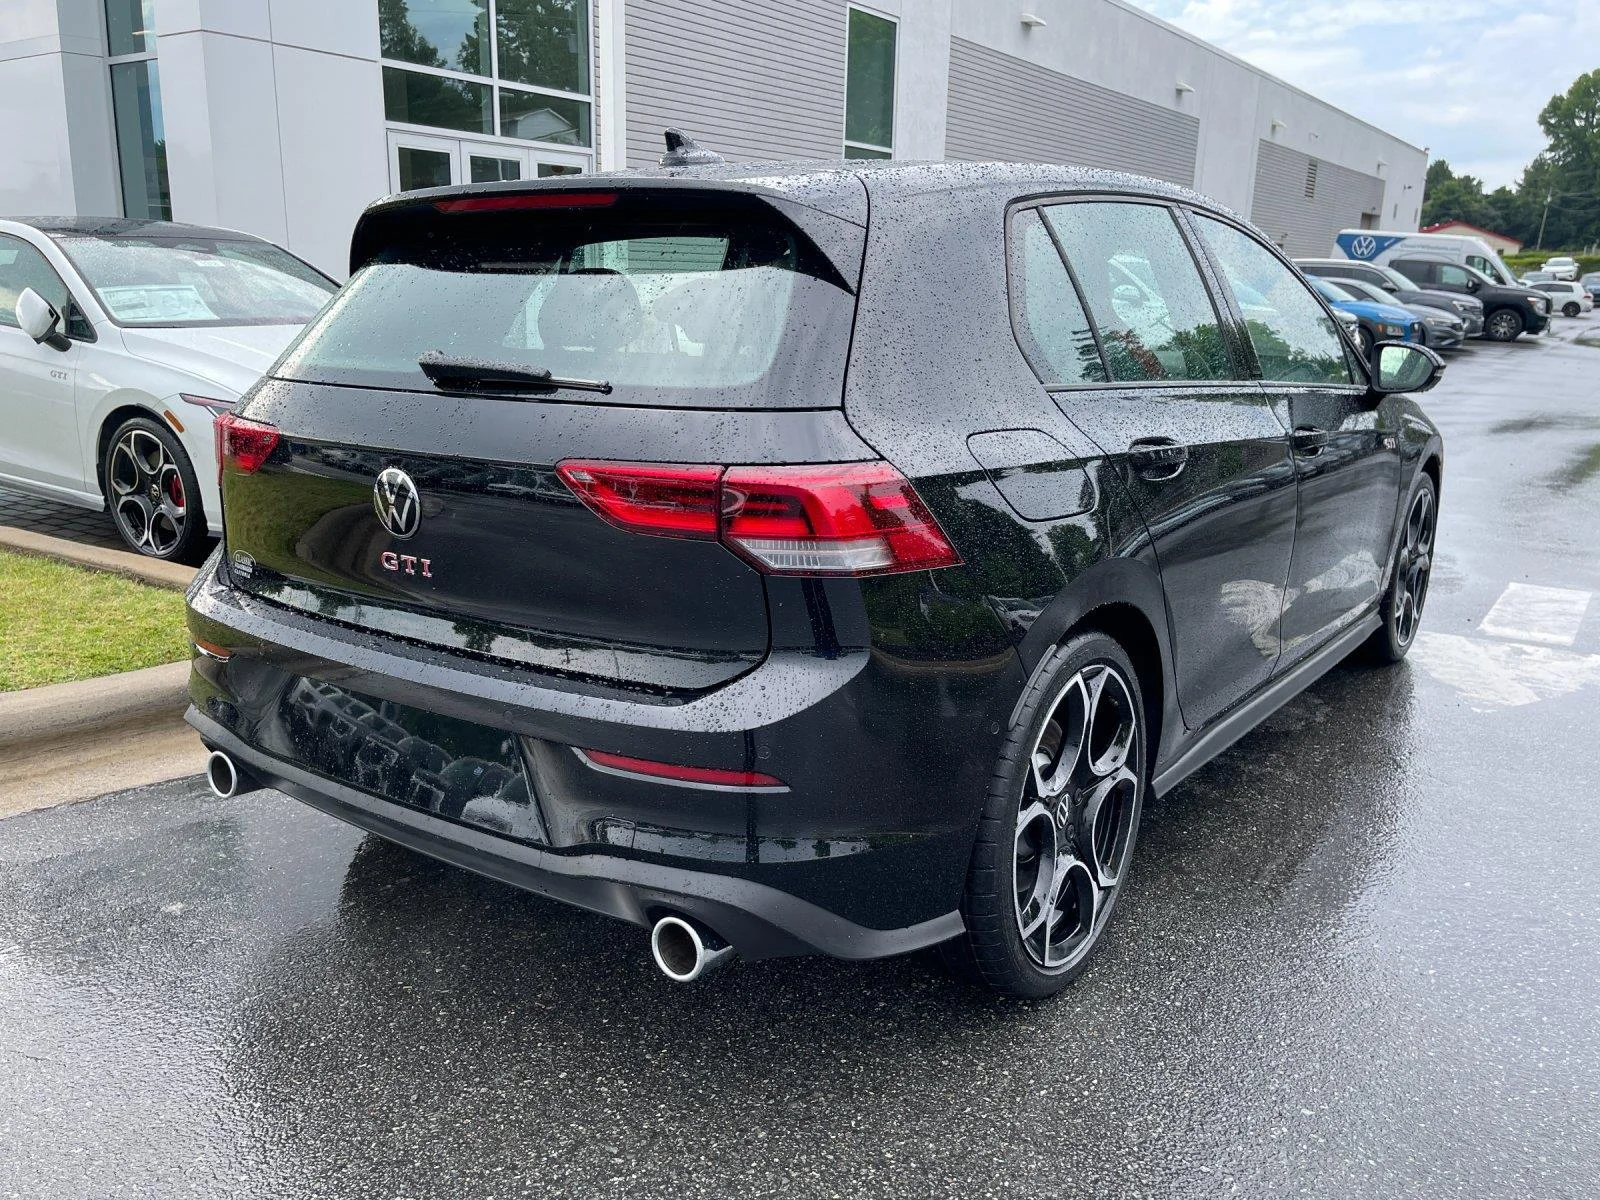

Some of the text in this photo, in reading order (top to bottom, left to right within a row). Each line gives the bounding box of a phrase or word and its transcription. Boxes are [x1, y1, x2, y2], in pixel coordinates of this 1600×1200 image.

[1352, 236, 1376, 258] VW
[50, 369, 68, 380] GTI
[374, 468, 421, 540] VW
[381, 551, 432, 578] GTI
